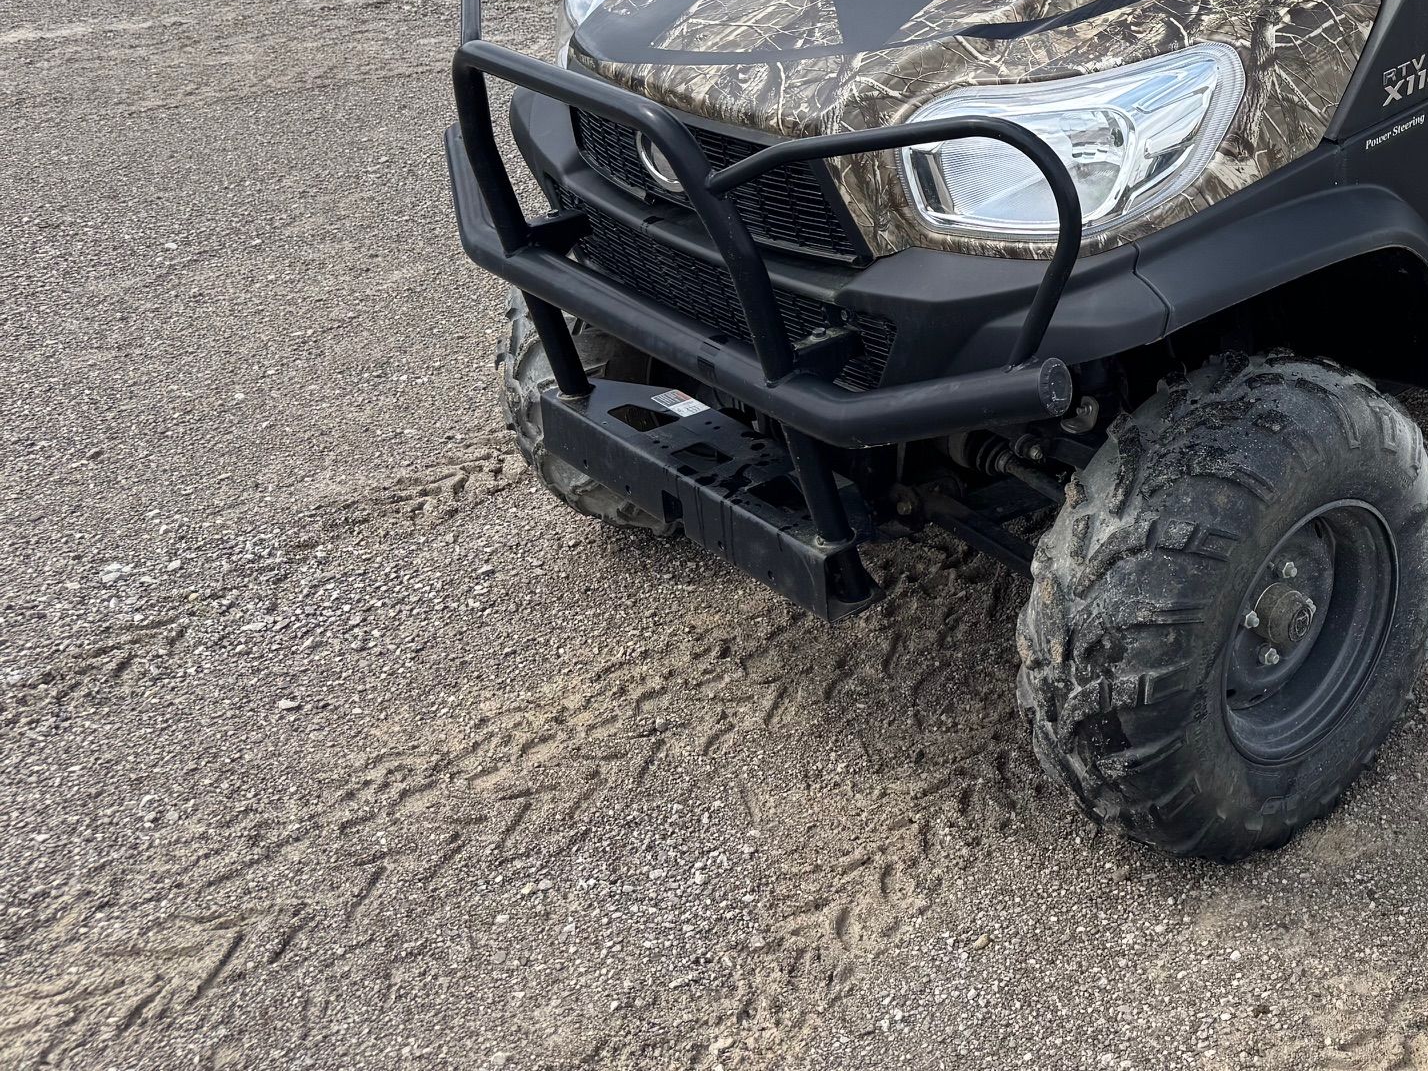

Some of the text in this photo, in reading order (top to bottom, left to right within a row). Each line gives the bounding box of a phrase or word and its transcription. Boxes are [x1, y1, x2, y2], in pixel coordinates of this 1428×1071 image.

[1383, 54, 1426, 86] RTV
[1365, 114, 1425, 150] Power Steering
